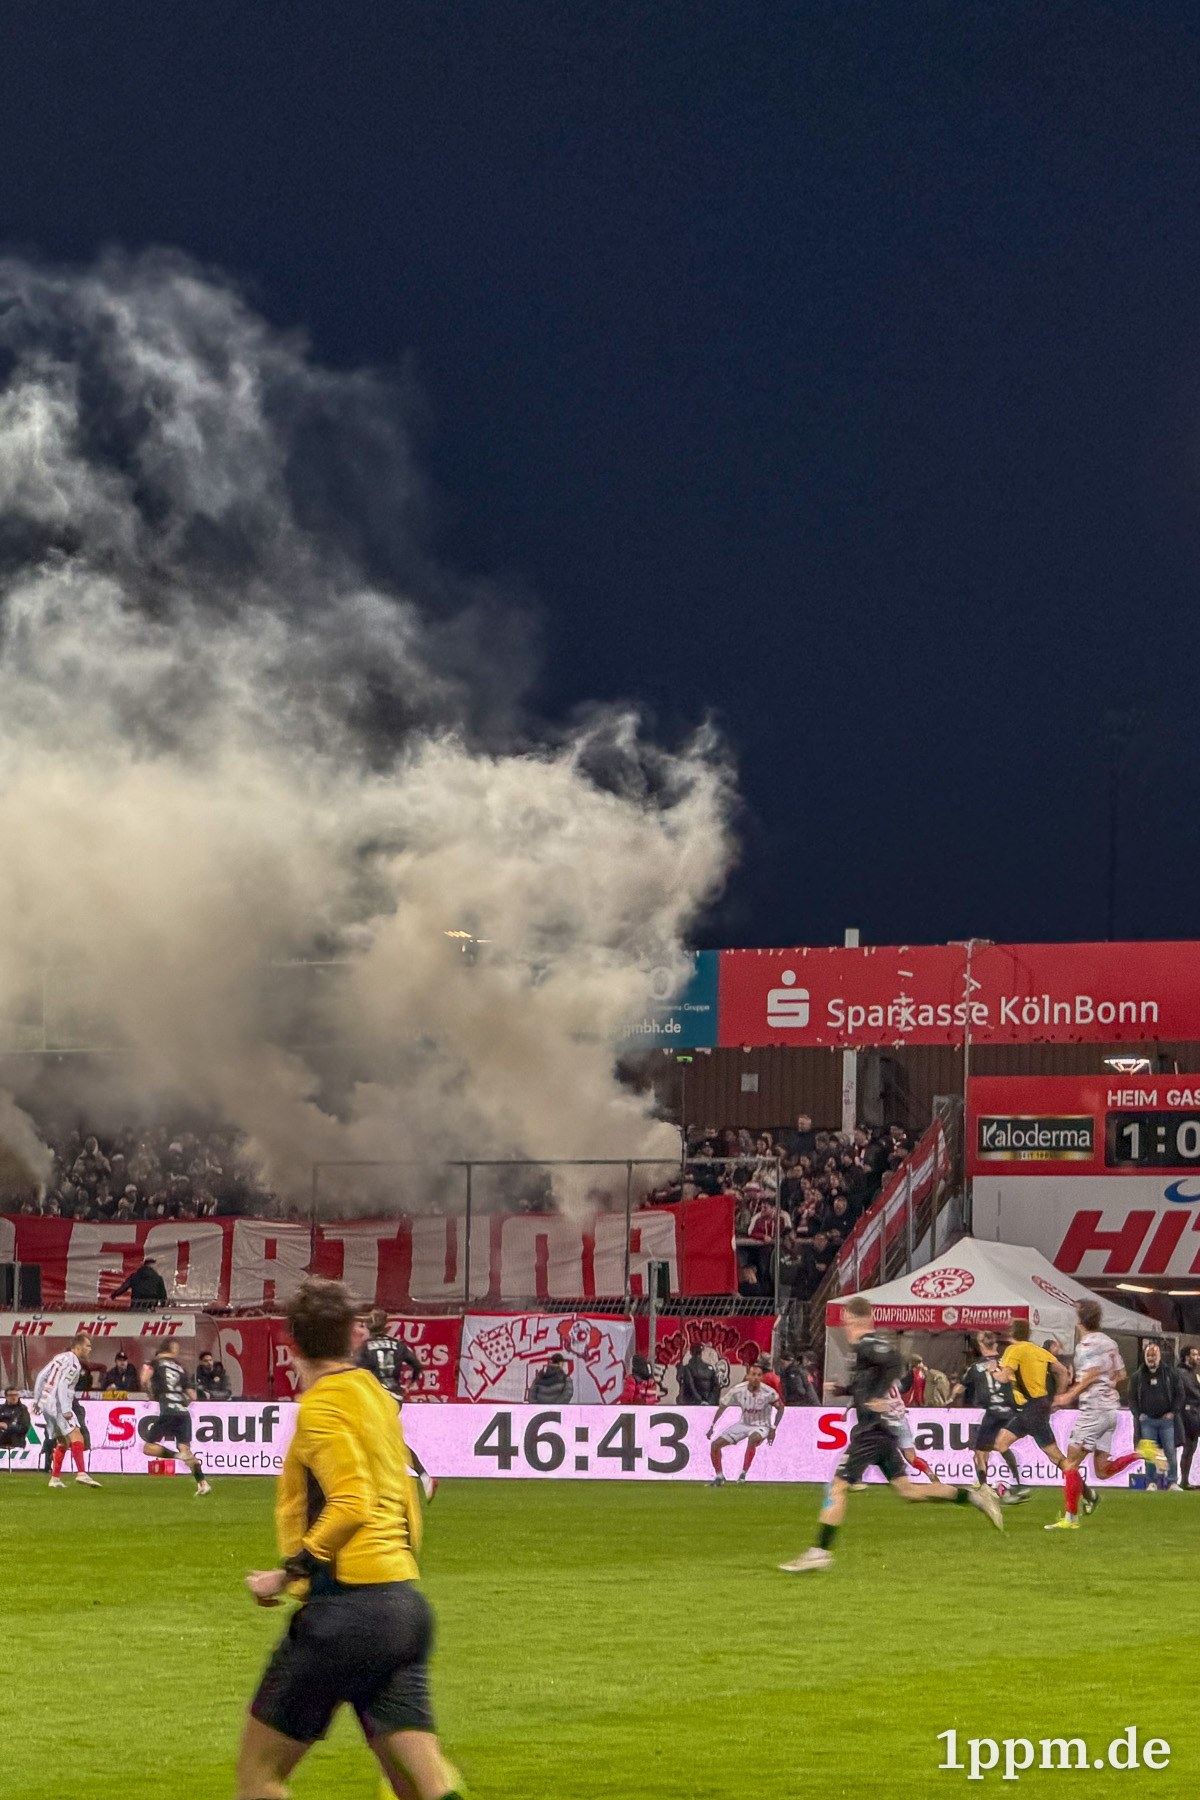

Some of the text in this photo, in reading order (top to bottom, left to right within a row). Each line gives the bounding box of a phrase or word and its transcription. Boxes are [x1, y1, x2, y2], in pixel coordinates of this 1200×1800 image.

[826, 994, 1159, 1035] Sparkasse KölnBonn
[1106, 1089, 1158, 1107] HEIM
[982, 1121, 1091, 1149] Kaloderma
[1122, 1120, 1200, 1160] 1:0
[65, 1208, 680, 1305] FORTUNA
[10, 1316, 183, 1336] HIT HIT HIT
[870, 1307, 936, 1323] KOMPROMISSE
[474, 1411, 690, 1474] 46:43
